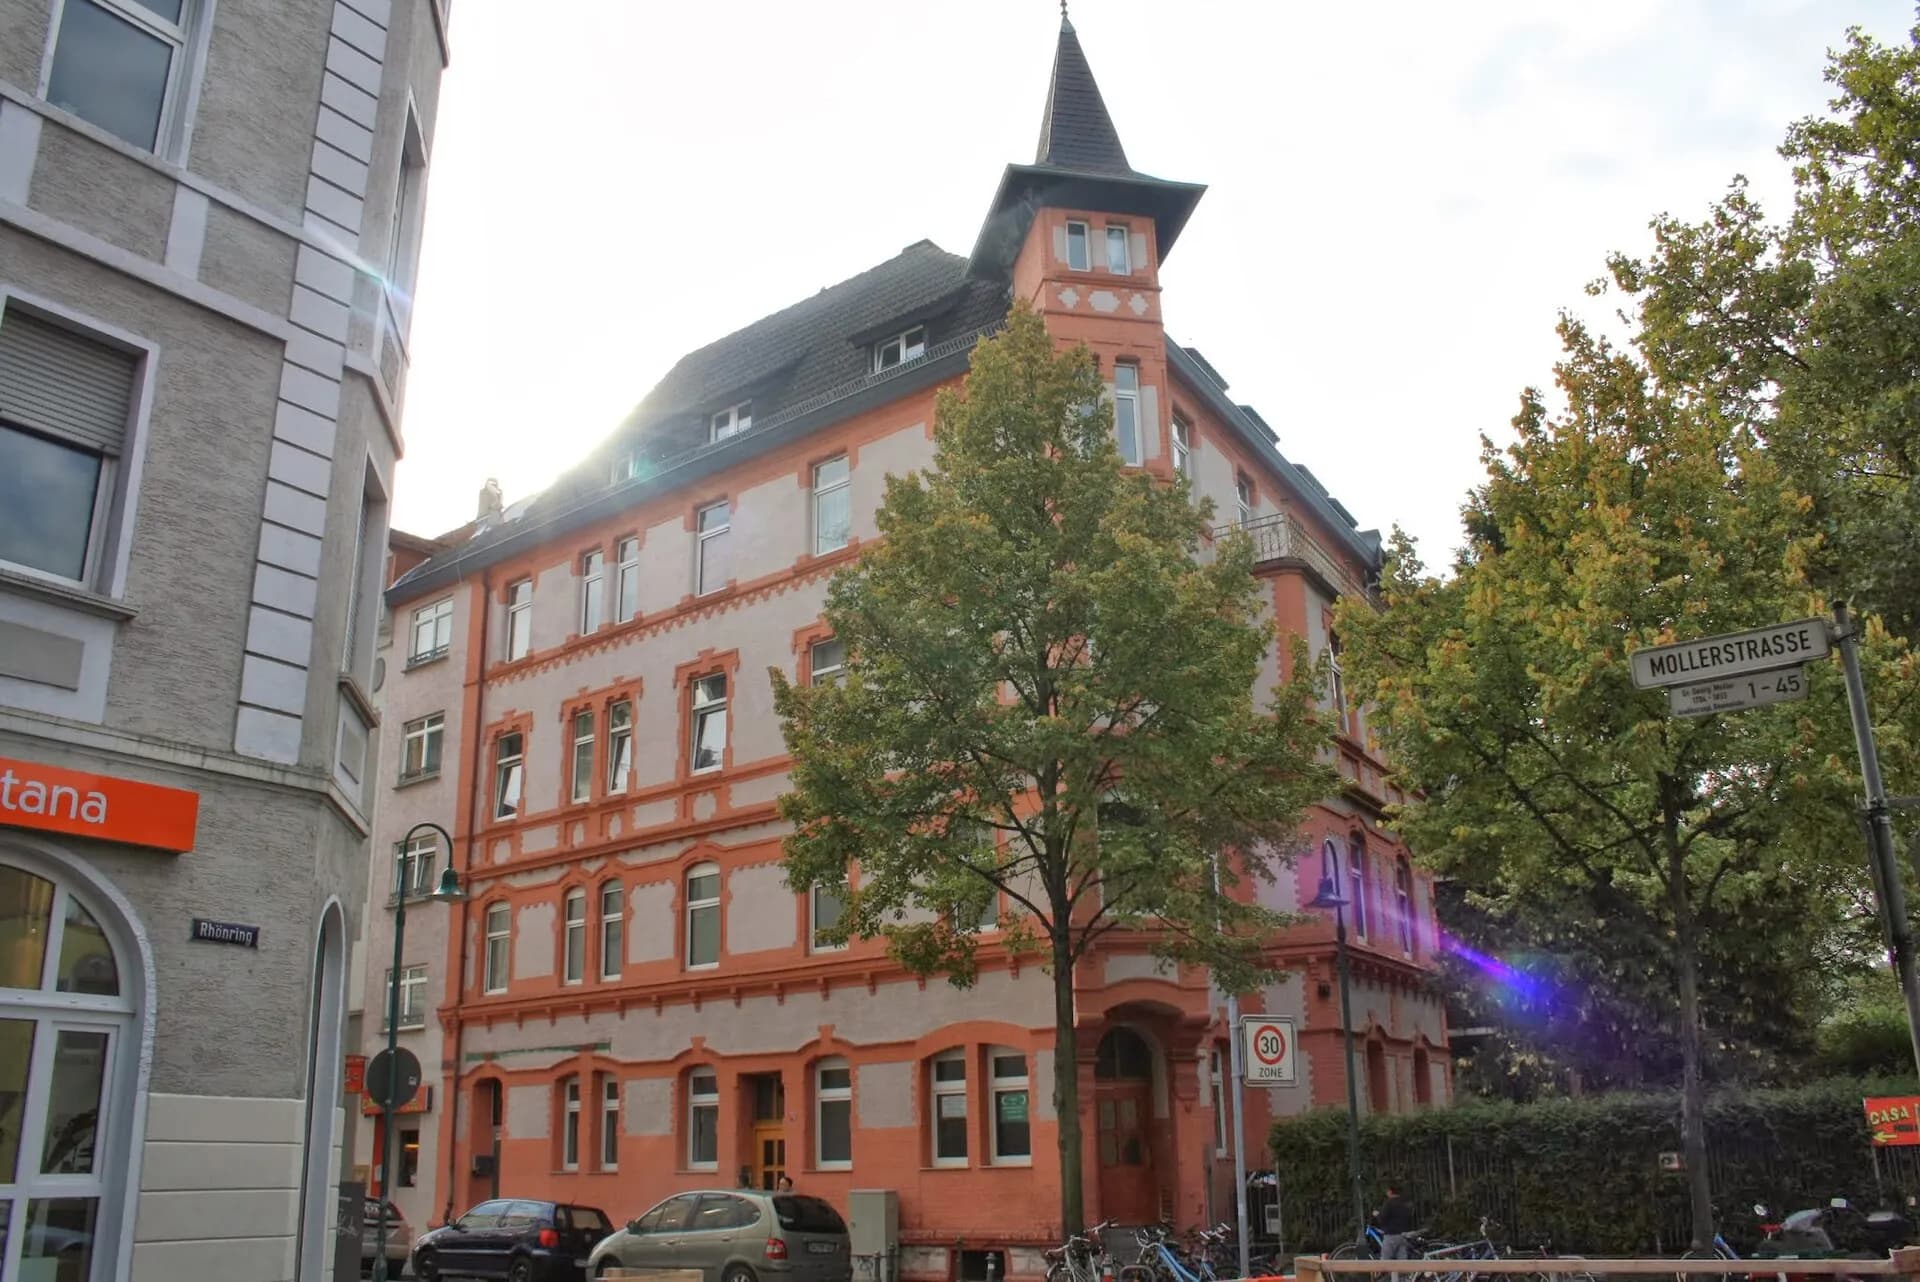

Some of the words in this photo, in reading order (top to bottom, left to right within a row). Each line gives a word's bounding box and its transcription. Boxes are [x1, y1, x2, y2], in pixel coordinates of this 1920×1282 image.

[1650, 629, 1812, 677] MOLLERSTRASSE
[0, 769, 107, 824] tana
[200, 922, 253, 947] Rhönring
[1260, 1036, 1279, 1054] 30
[1259, 1067, 1283, 1078] ZONE
[1870, 1105, 1909, 1125] CASA
